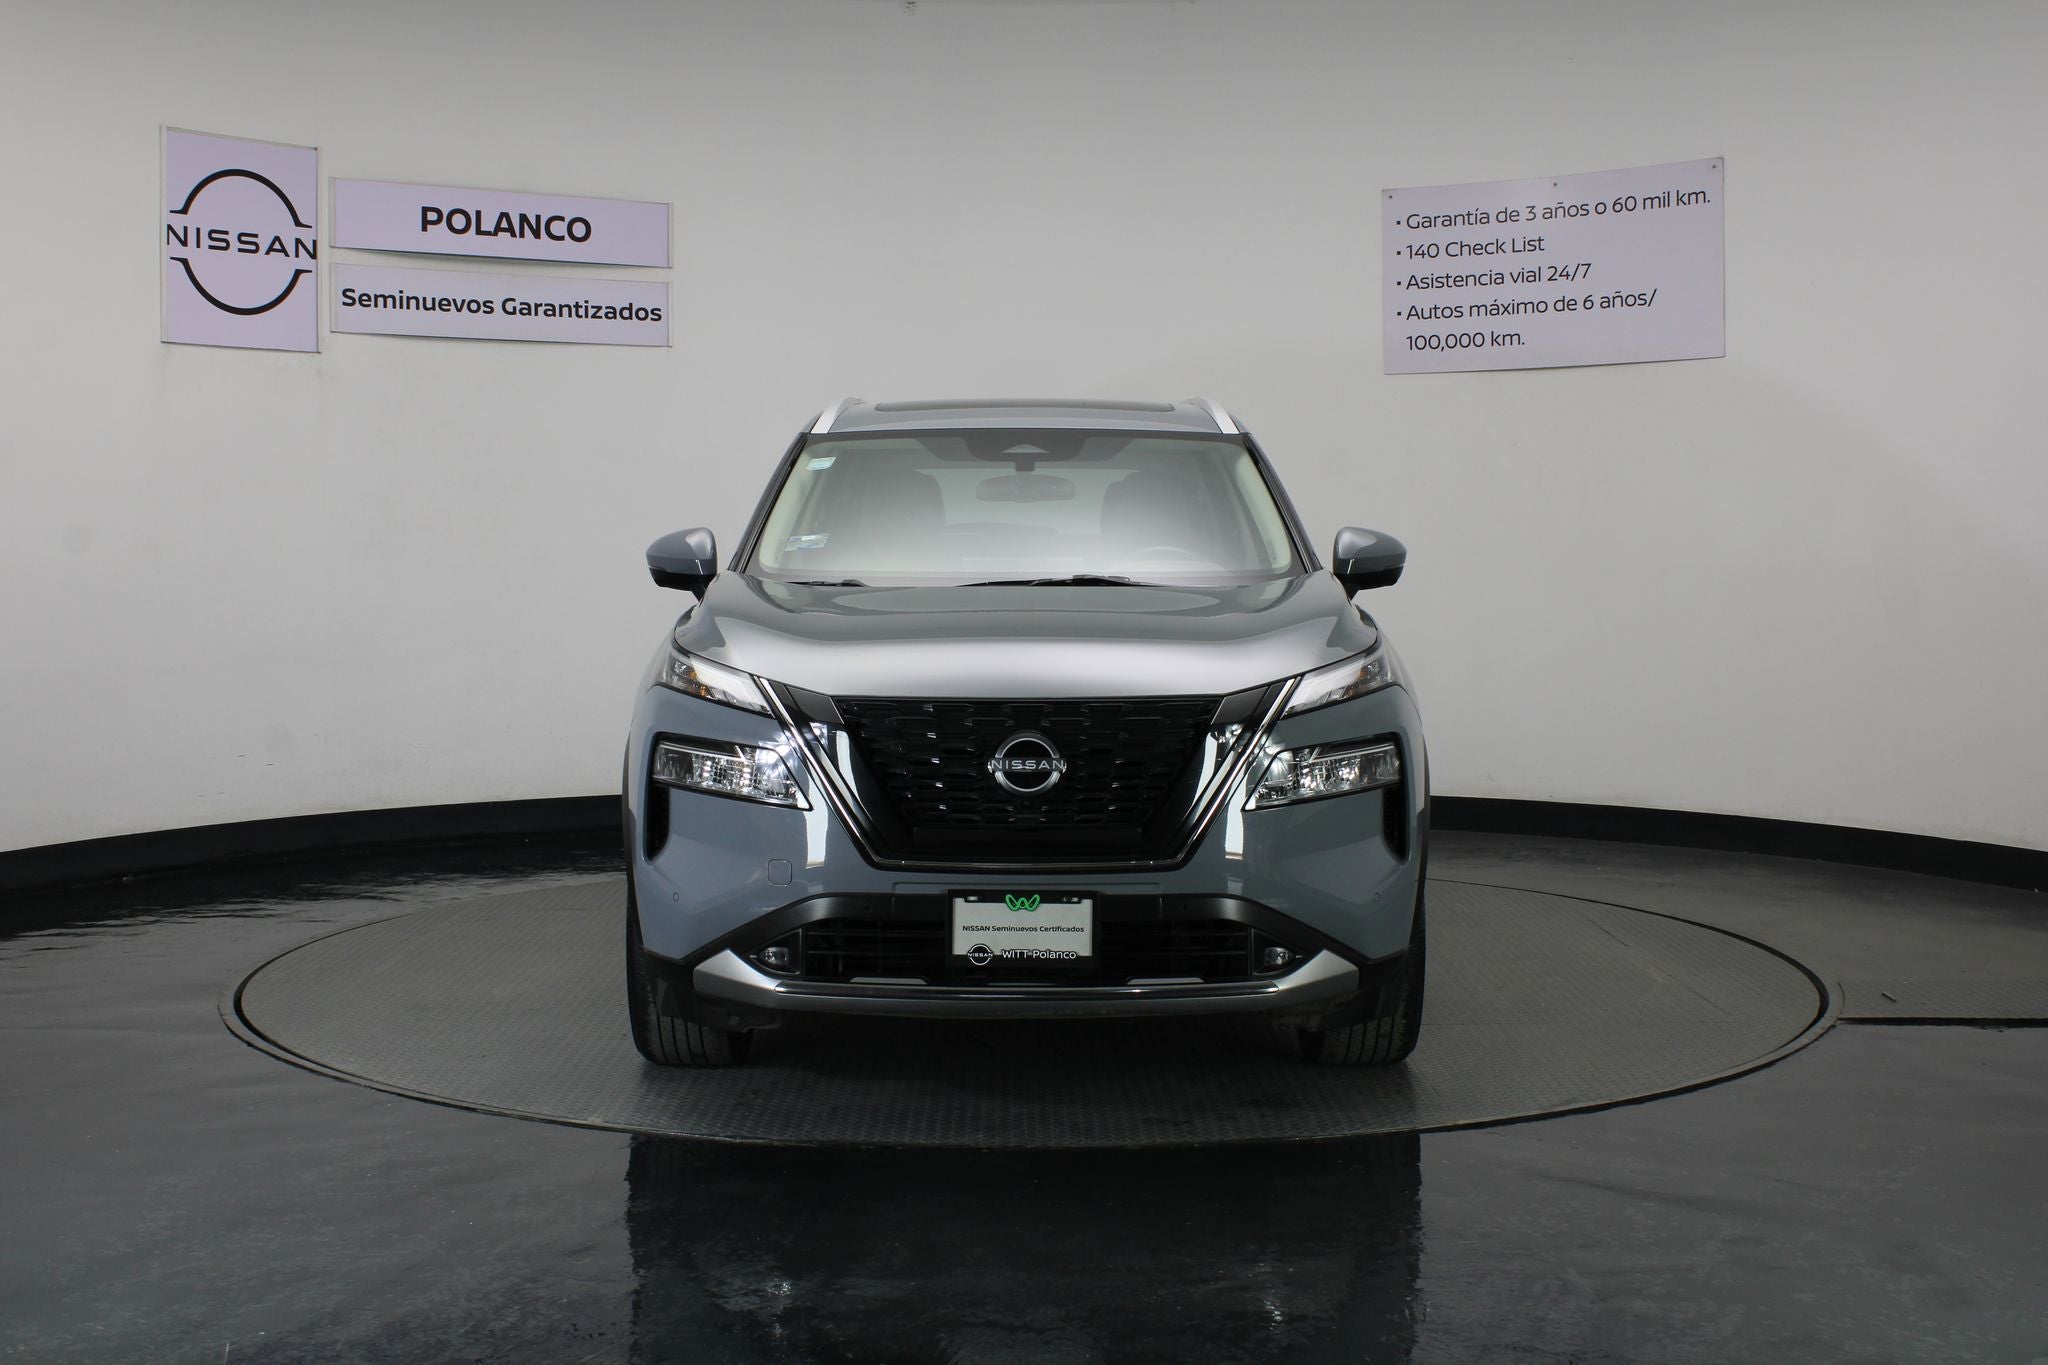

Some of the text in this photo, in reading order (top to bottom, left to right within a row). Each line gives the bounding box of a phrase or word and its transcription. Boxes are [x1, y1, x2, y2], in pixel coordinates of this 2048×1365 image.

[1406, 189, 1711, 230] Garantía de 3 años o 60 mil km.
[420, 206, 592, 243] POLANCO
[167, 223, 317, 260] NISSAN
[1406, 235, 1545, 260] 140 Check List
[1406, 263, 1592, 290] Asistencia vial 24/7
[341, 287, 662, 322] Seminuevos Garantizados
[1406, 288, 1657, 321] Autos máximo de 6 años/
[1406, 329, 1526, 352] 100,000 km.
[991, 759, 1064, 770] NISSAN
[1039, 925, 1085, 933] Certificados
[1002, 949, 1077, 959] WITT Polanco
